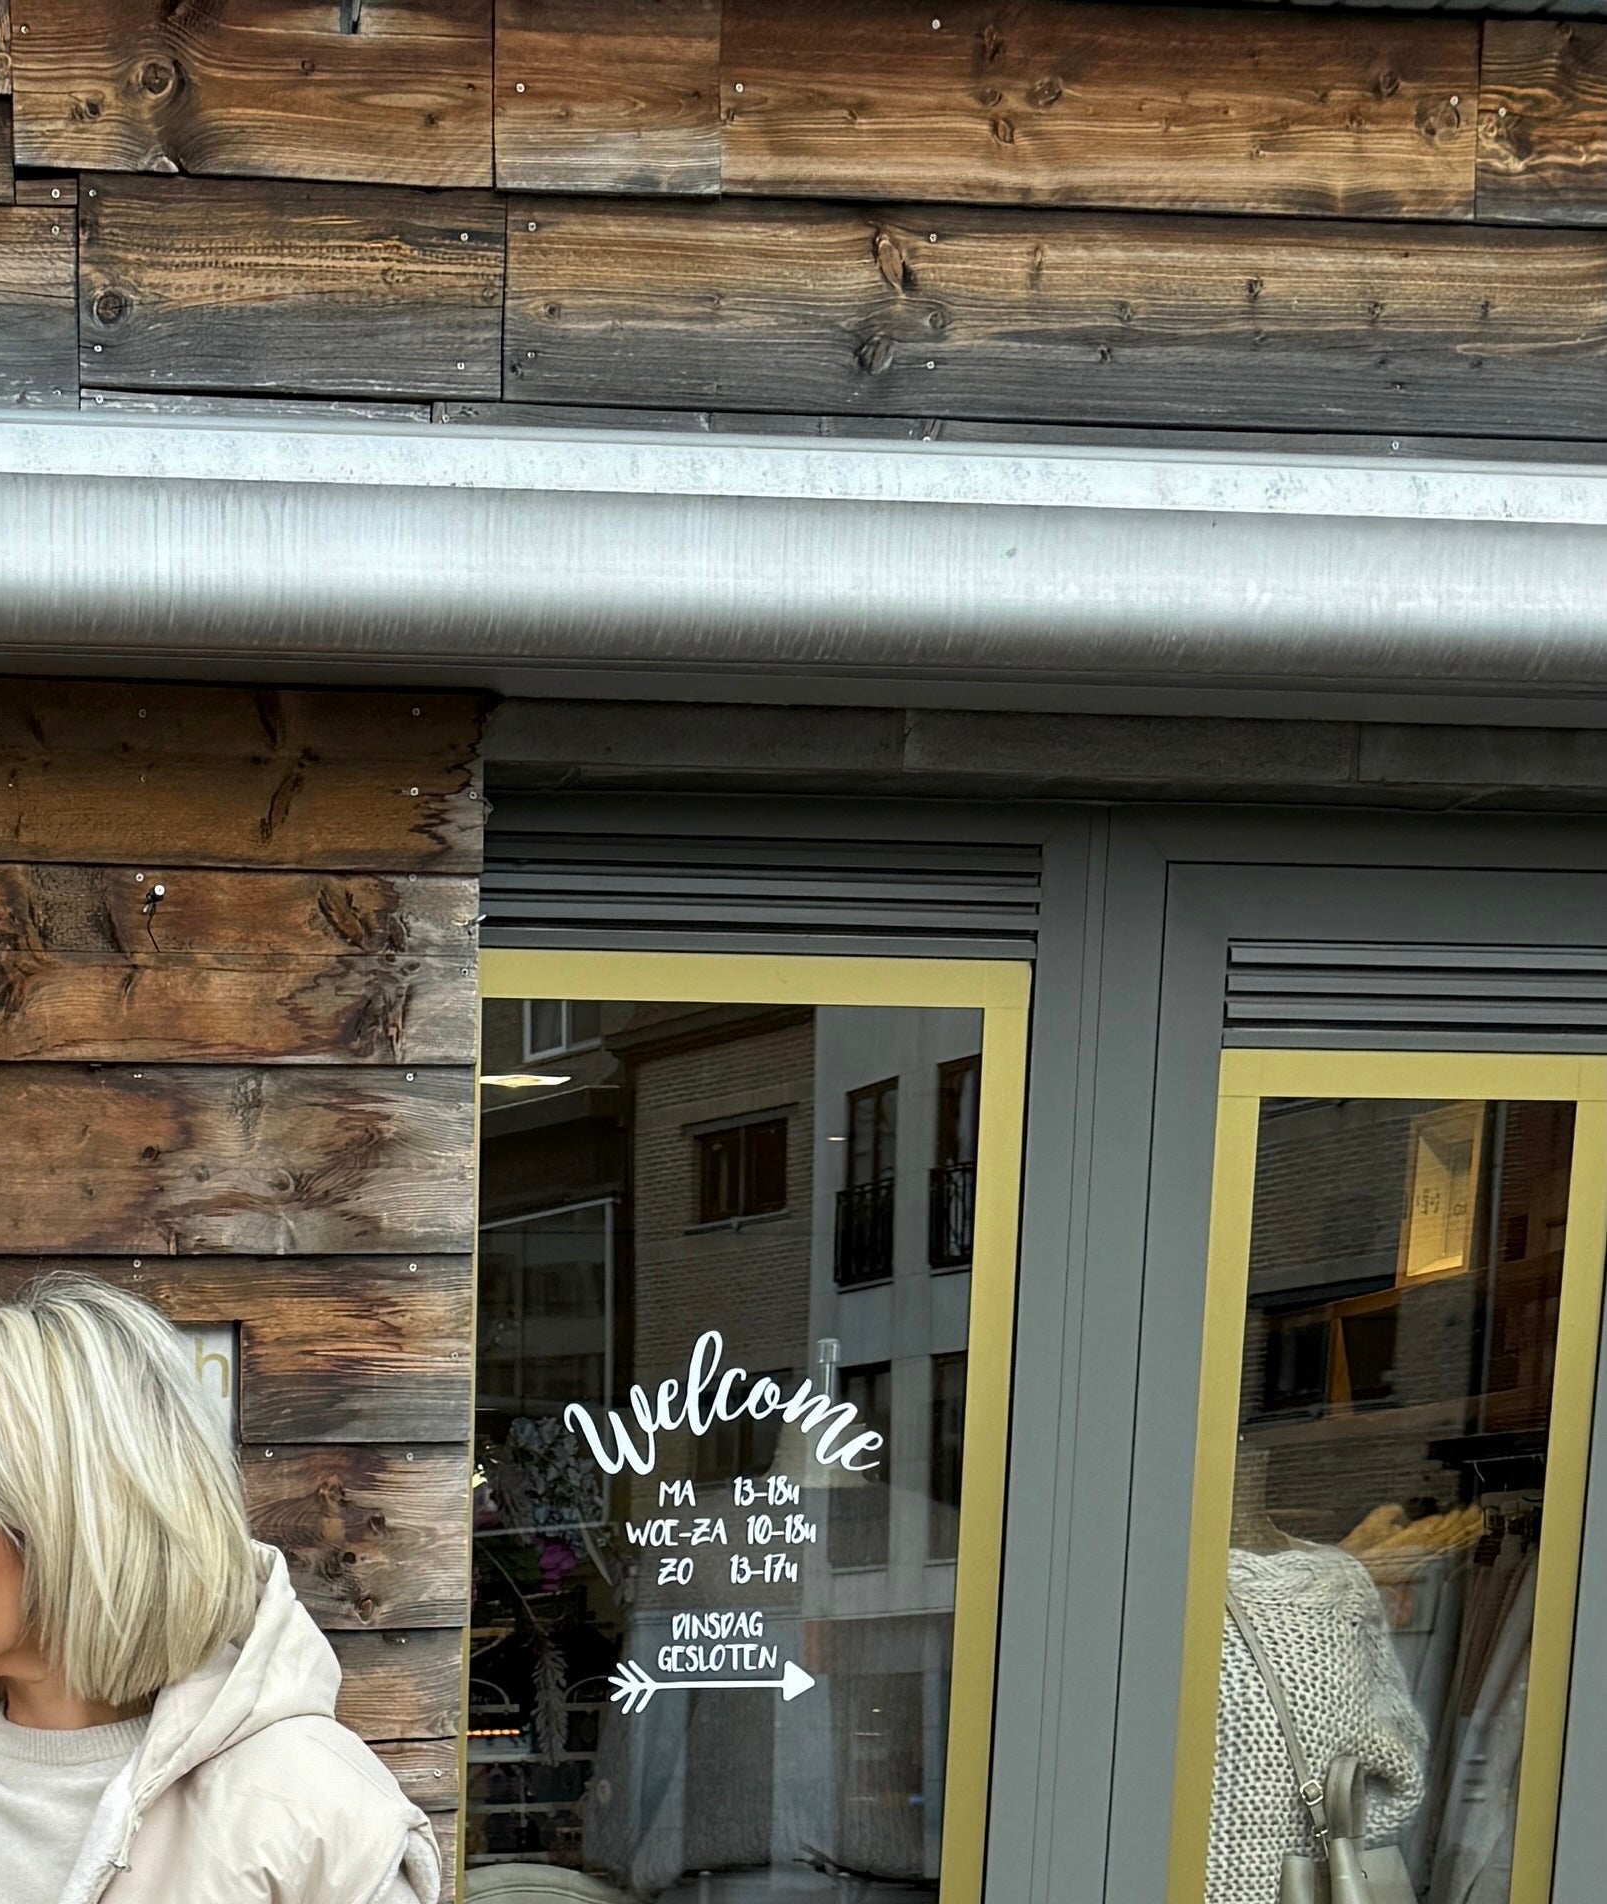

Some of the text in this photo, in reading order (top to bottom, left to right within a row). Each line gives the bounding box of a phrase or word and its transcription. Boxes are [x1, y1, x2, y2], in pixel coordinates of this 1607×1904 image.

[563, 1330, 884, 1476] Welcome
[658, 1479, 696, 1507] MA
[625, 1517, 728, 1547] WOE-ZA
[657, 1557, 694, 1586] ZO
[671, 1611, 764, 1641] DINSDAG
[657, 1643, 778, 1673] GESLOTEN
